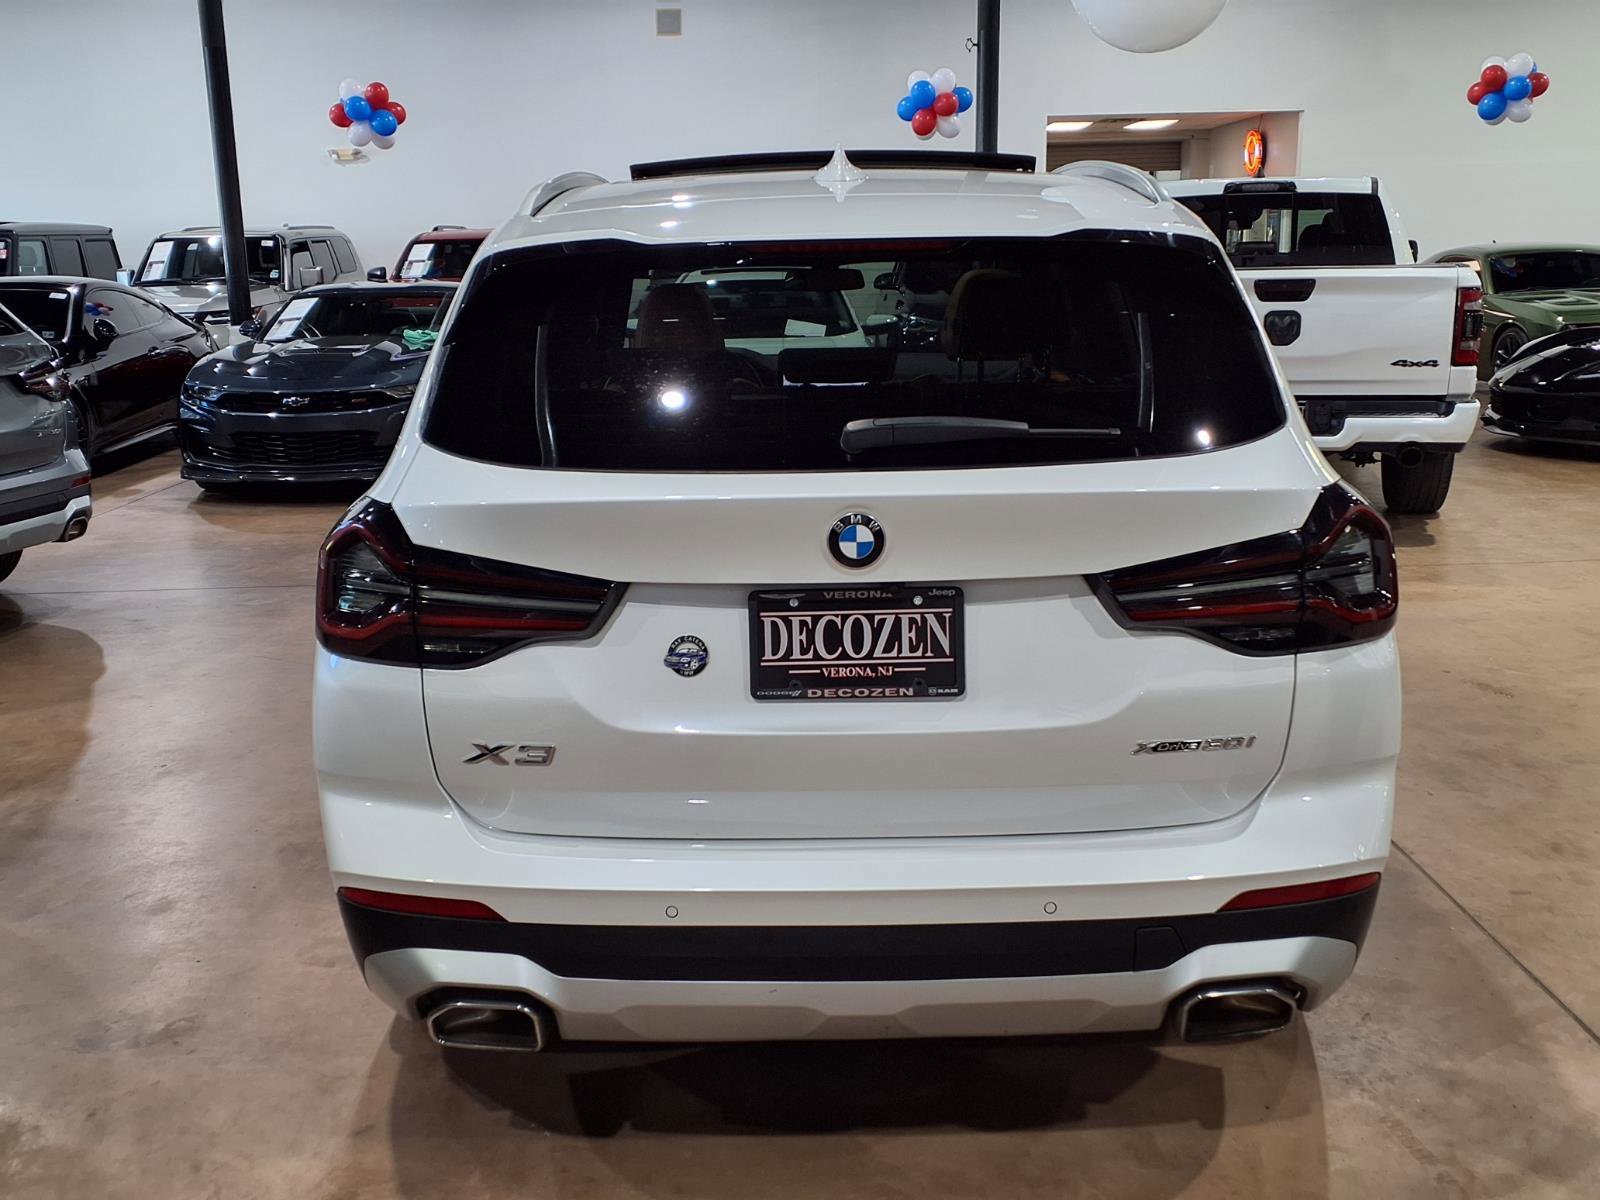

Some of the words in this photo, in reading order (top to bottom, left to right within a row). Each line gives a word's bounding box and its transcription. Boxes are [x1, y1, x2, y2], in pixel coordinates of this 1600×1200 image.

[1390, 359, 1440, 368] 4x4
[833, 514, 880, 533] BMW
[928, 588, 956, 597] Jeep
[760, 613, 953, 661] DECOZEN
[822, 667, 876, 678] VERONA,
[877, 666, 893, 676] NJ
[807, 687, 914, 698] DECOZEN
[462, 742, 557, 767] X3
